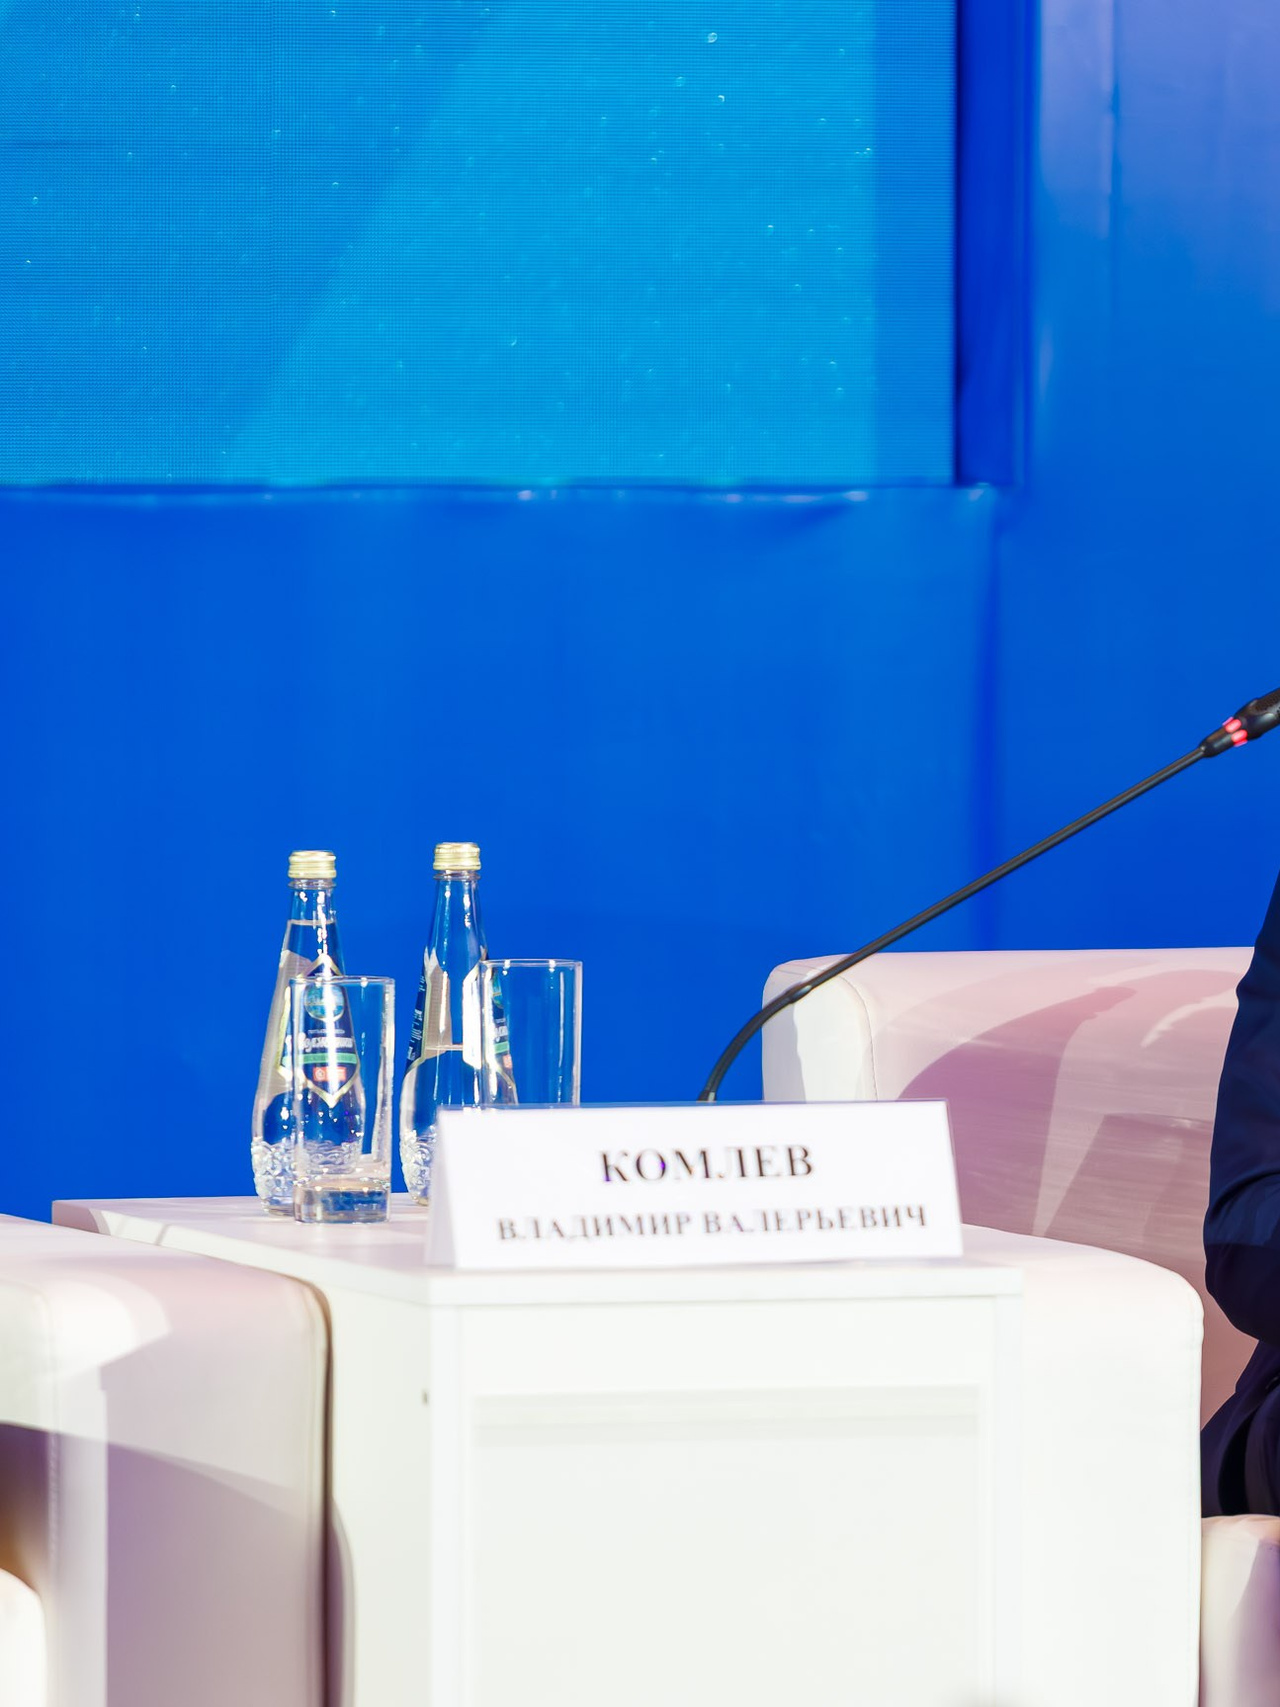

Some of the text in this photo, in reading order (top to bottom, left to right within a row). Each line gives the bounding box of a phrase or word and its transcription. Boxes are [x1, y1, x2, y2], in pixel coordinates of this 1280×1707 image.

[601, 1144, 814, 1183] КОМЛЕВ
[497, 1204, 927, 1241] ВЛАДИМИР ВАЛЕРЬЕВИЧ
